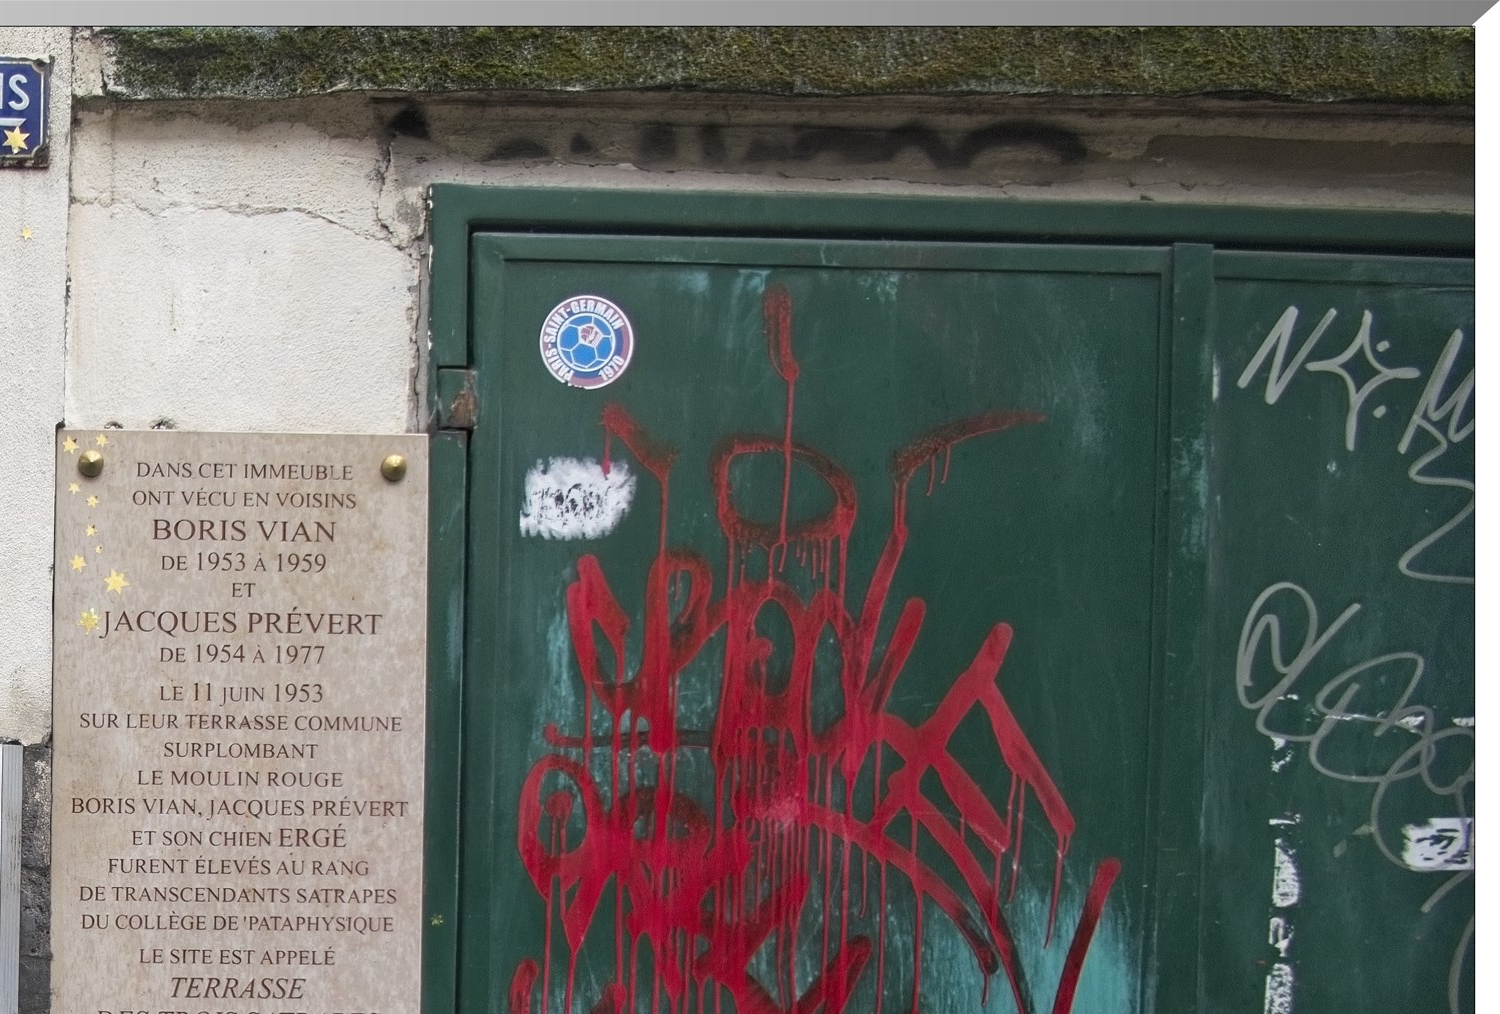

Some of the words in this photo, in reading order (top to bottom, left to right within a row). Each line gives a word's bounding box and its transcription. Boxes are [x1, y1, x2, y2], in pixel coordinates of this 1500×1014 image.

[598, 355, 625, 381] 1970
[136, 462, 192, 479] DANS
[199, 463, 238, 479] CET
[243, 464, 354, 481] IMMEUBLE
[132, 490, 176, 507] ONT
[181, 487, 237, 508] VÉCU
[243, 492, 270, 508] EN
[276, 492, 358, 510] VOISINS
[152, 518, 247, 542] BORIS
[256, 520, 337, 543] VIAN
[161, 555, 188, 571] DE
[197, 551, 246, 572] 1953
[253, 553, 268, 572] À
[277, 553, 327, 574] 1959
[231, 582, 256, 599] ET
[99, 610, 238, 638] JACQUES
[247, 606, 384, 635] PRÉVERT
[160, 647, 187, 663] DE
[196, 644, 246, 664] 1954
[252, 645, 266, 664] À
[275, 645, 326, 665] 1977
[160, 685, 184, 702] LE
[192, 682, 213, 702] 11
[218, 686, 265, 707] JUIN
[274, 683, 324, 703] 1953
[79, 713, 119, 729] SUR
[126, 713, 179, 730] LEUR
[185, 714, 289, 731] TERRASSE
[294, 716, 403, 732] COMMUNE
[163, 742, 319, 759] SURPLOMBANT
[137, 770, 163, 786] LE
[171, 770, 260, 787] MOULIN
[267, 772, 344, 788] ROUGE
[71, 797, 136, 815] BORIS
[142, 798, 203, 818] VIAN,
[206, 799, 305, 821] JACQUES
[312, 797, 410, 817] PRÉVERT
[131, 830, 157, 846] ET
[162, 831, 203, 847] SON
[208, 831, 272, 847] CHIEN
[278, 823, 347, 848] ERGÉ
[108, 859, 189, 875] FURENT
[195, 855, 271, 876] ÉLEVÉS
[276, 861, 305, 876] AU
[311, 860, 370, 876] RANG
[79, 885, 106, 902] DE
[112, 886, 291, 904] TRANSCENDANTS
[296, 888, 398, 904] SATRAPES
[81, 914, 110, 930] DU
[114, 911, 207, 931] COLLÈGE
[212, 915, 239, 931] DE
[139, 949, 164, 964] LE
[169, 949, 214, 965] SITE
[219, 949, 255, 965] EST
[260, 946, 336, 966] APPELÉ
[170, 977, 307, 999] TERRASSE
